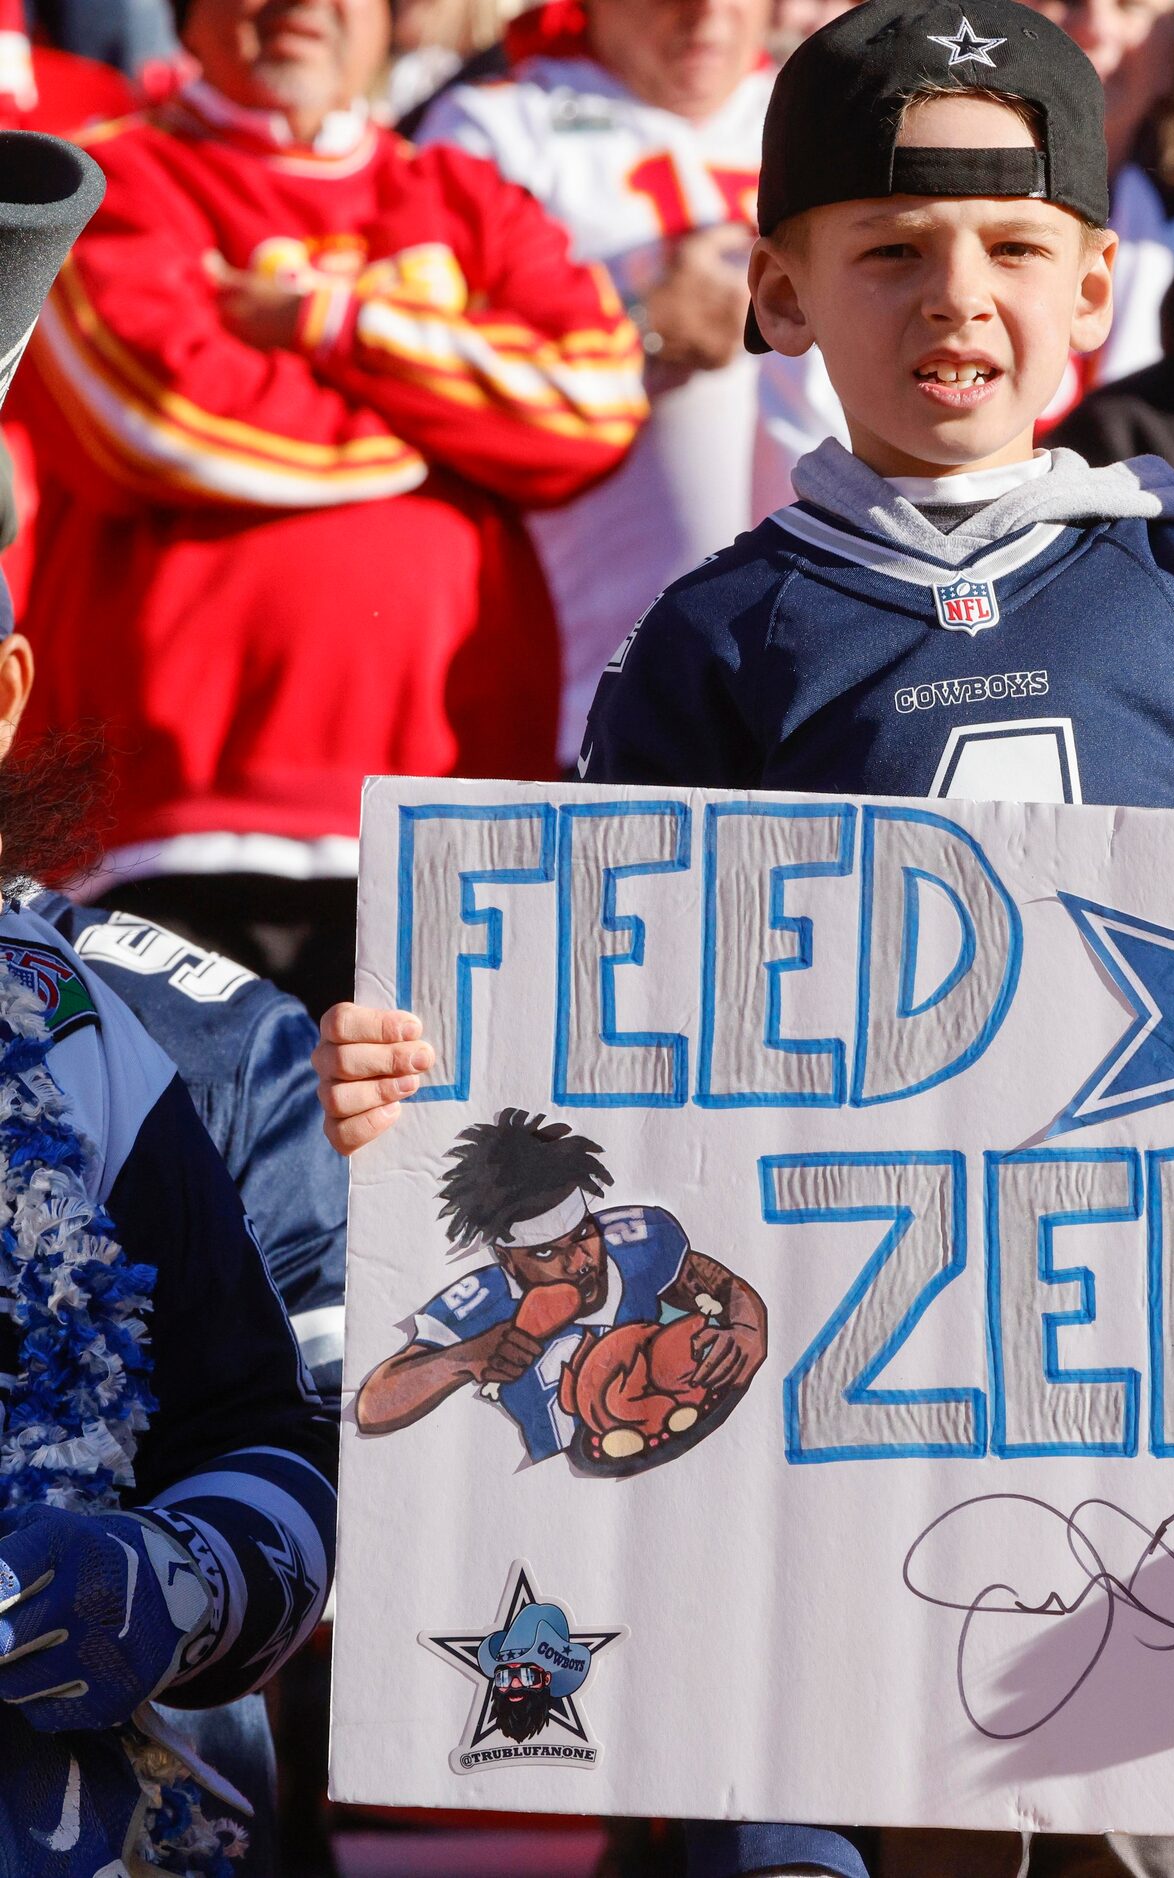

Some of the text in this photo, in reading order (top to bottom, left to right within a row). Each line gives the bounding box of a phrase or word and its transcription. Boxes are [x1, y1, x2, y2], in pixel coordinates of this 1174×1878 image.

[944, 598, 990, 622] NFL
[895, 670, 1049, 713] COWBOYS
[396, 802, 1024, 1108] FEED
[441, 1275, 490, 1321] 21
[536, 1641, 586, 1673] COWBOYS
[460, 1745, 597, 1769] @TRUBLUFANONE
